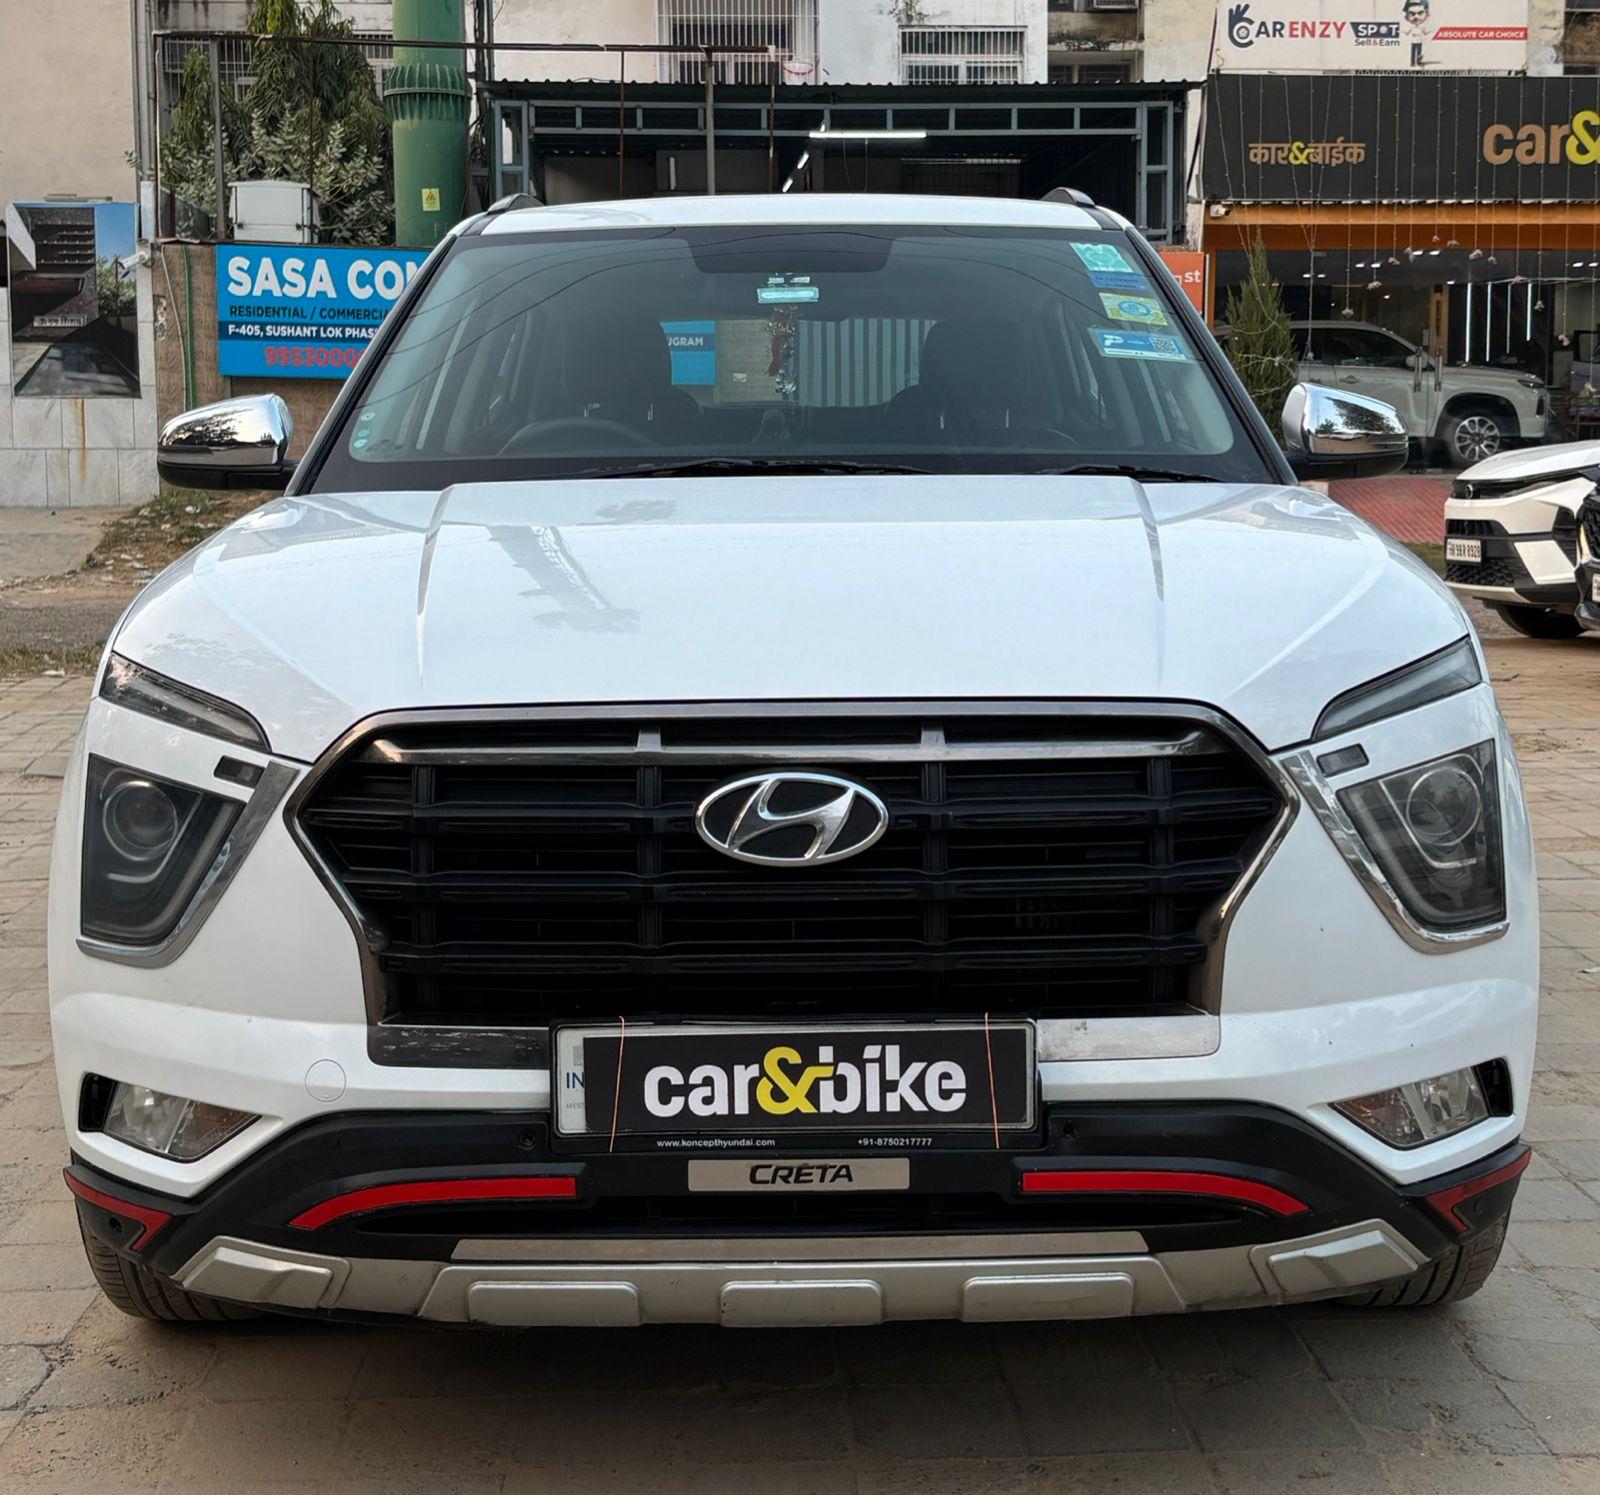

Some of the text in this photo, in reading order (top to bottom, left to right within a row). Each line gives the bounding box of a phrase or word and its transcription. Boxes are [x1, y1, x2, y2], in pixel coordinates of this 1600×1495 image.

[1437, 30, 1525, 39] ABSOLUTE CAR CHOICE
[227, 256, 337, 298] SASA
[229, 305, 307, 319] RESIDENTIAL
[228, 324, 264, 338] F-405,
[265, 325, 318, 338] SUSHANT
[320, 326, 343, 338] LOK
[264, 345, 367, 368] 9953000
[643, 1044, 967, 1118] car&bike
[656, 1137, 777, 1149] www.koncepthyundai.com
[857, 1136, 933, 1147] +91-8750217777
[750, 1163, 854, 1185] CRETA
